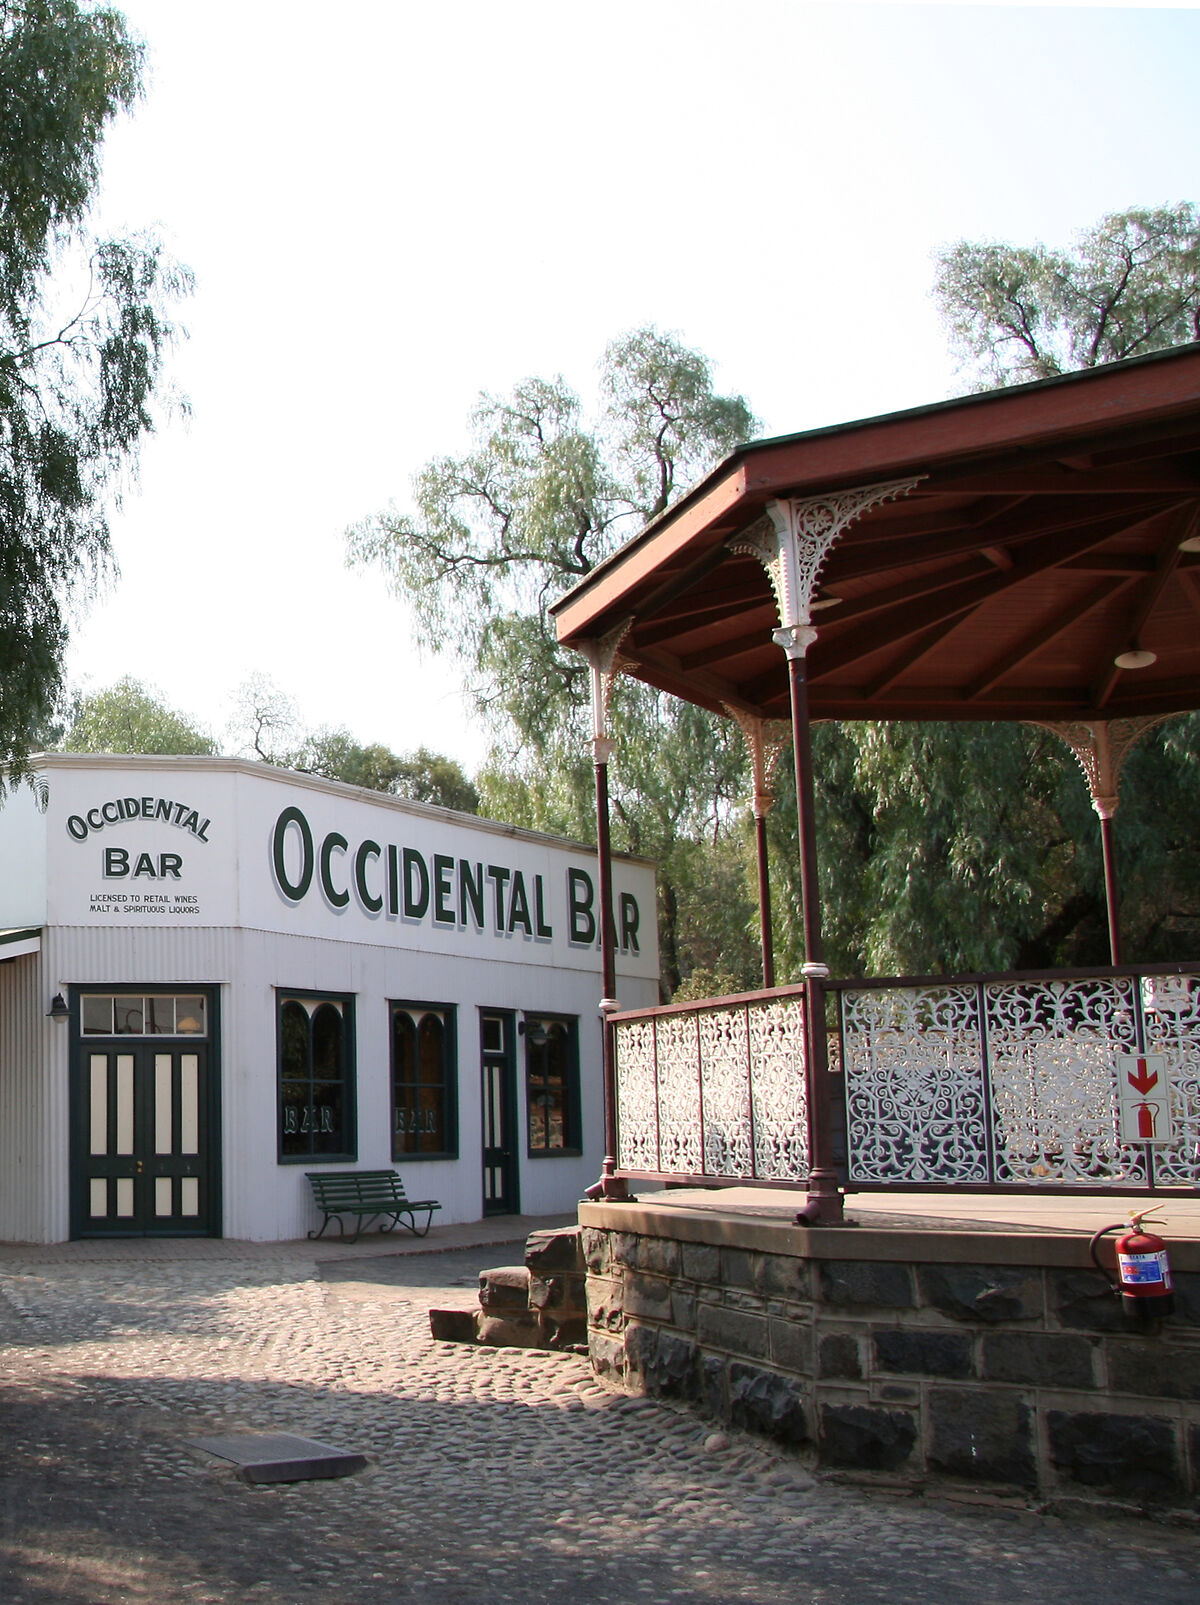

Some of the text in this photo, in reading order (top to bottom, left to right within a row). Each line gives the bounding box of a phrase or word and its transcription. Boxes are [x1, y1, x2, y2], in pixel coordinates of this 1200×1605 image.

[67, 797, 211, 843] OCCIDENTAL
[104, 847, 183, 878] BAR
[273, 806, 553, 939] OCCIDENTAL
[89, 905, 111, 913] MALT
[123, 905, 166, 914] SPIRITUOUS
[168, 906, 200, 915] LIQUORS
[90, 894, 198, 904] LICENSED TO RETAIL WINES
[284, 1104, 336, 1134] BAR
